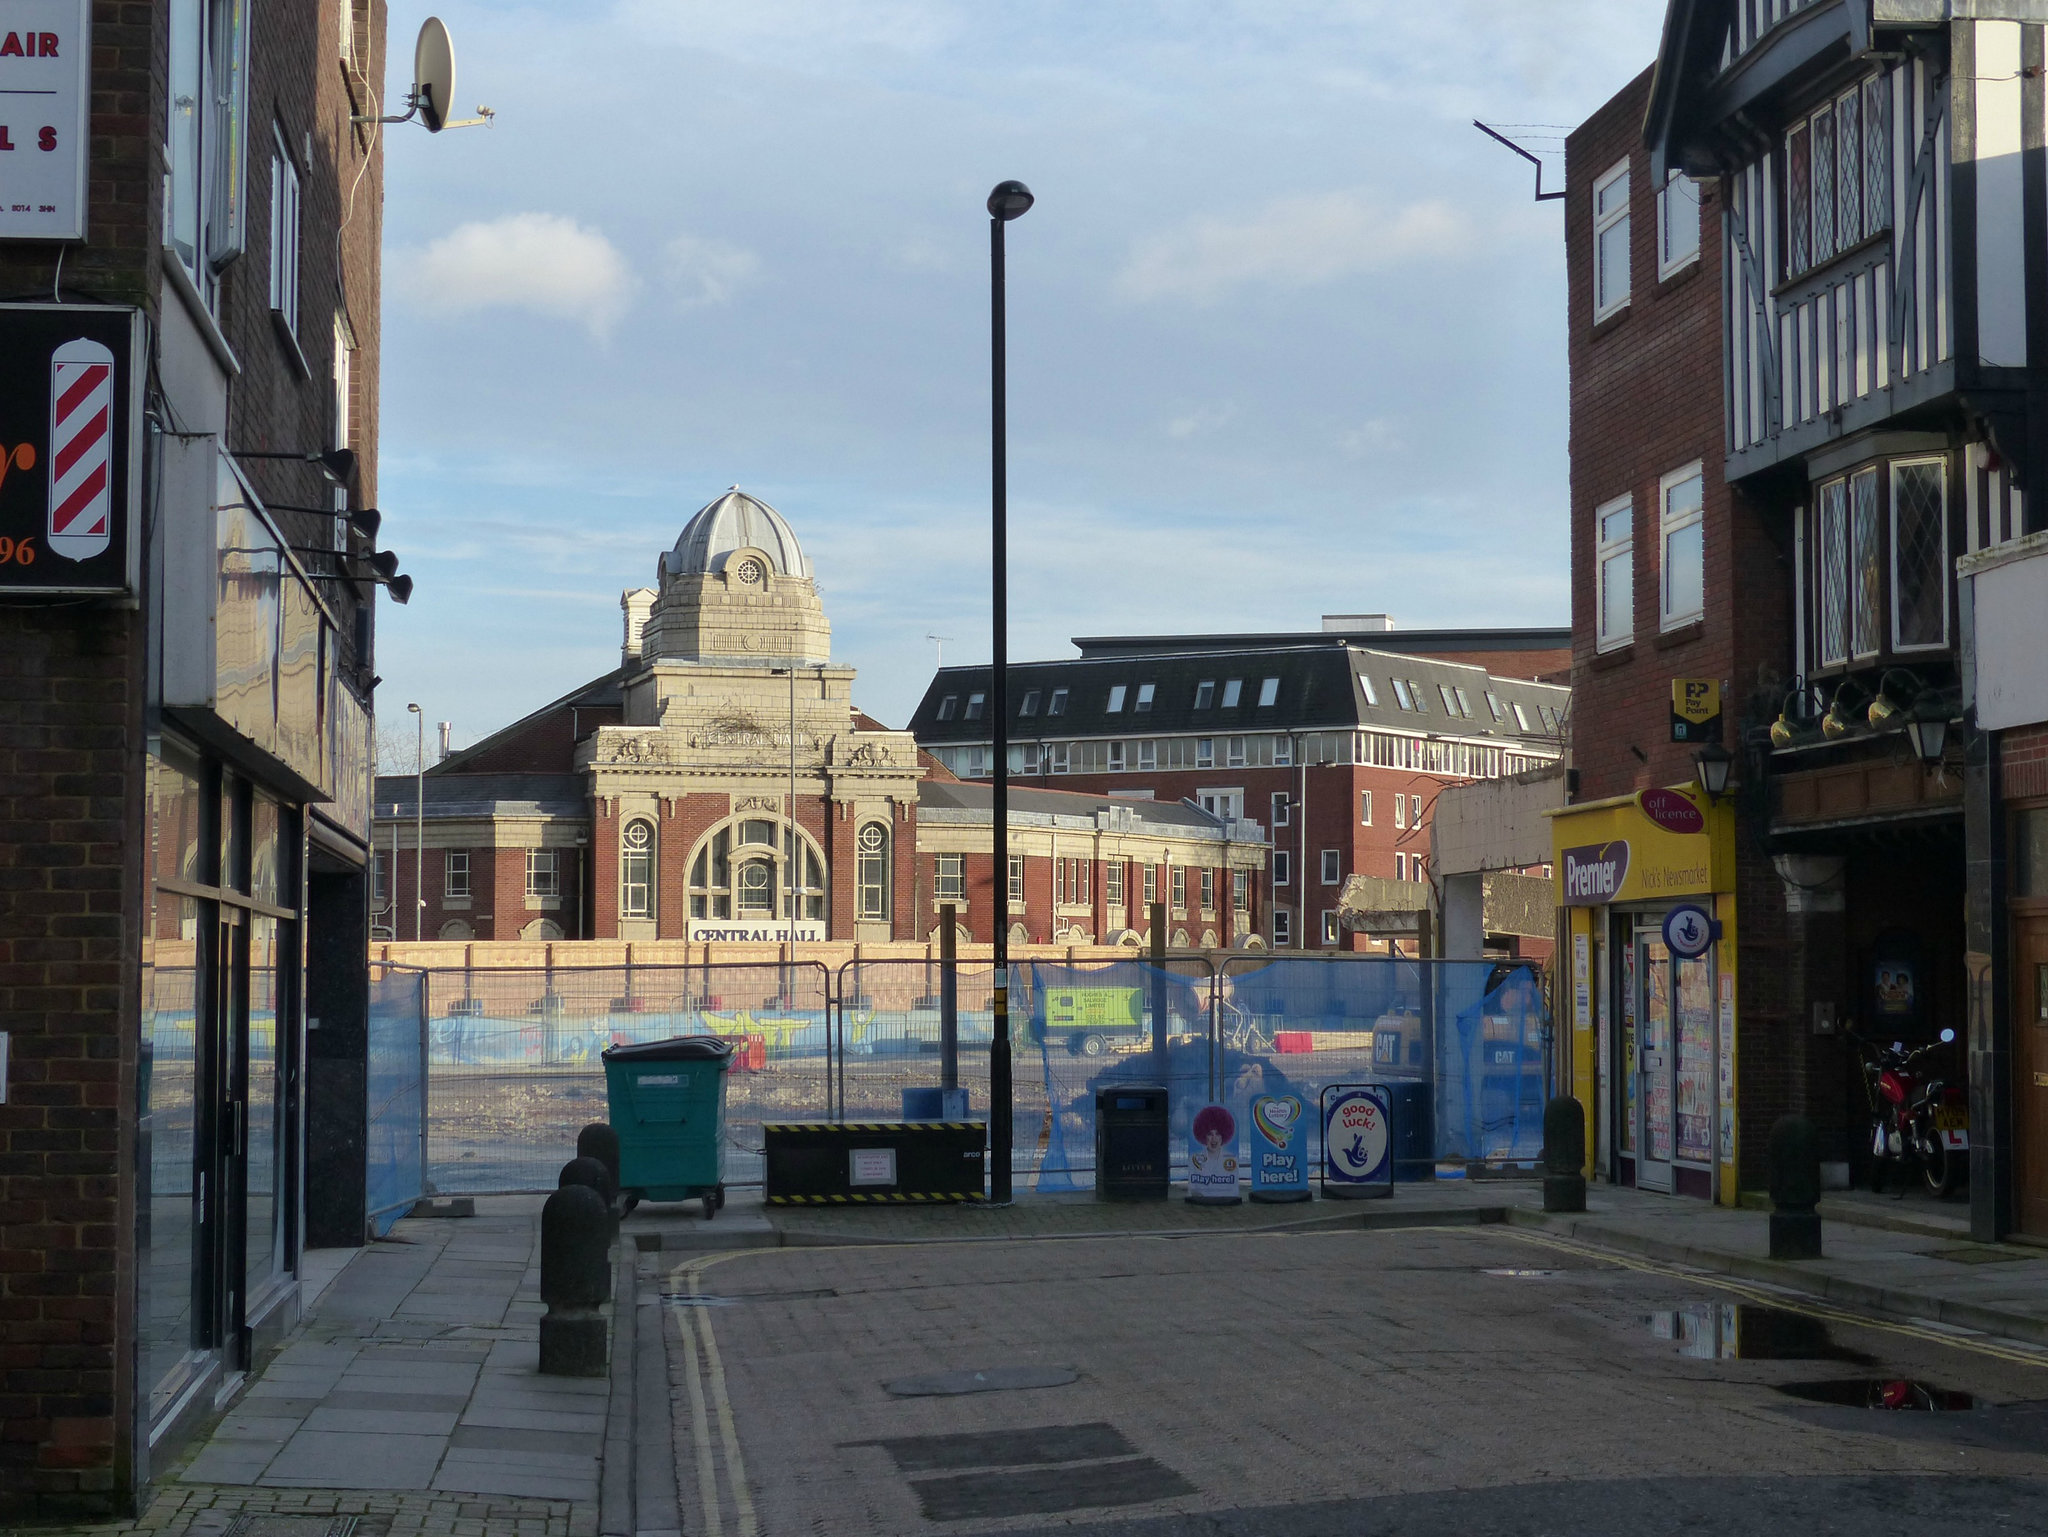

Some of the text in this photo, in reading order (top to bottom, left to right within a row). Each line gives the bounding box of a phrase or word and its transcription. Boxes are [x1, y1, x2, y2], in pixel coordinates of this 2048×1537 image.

[0, 32, 59, 57] AIR
[1686, 699, 1701, 708] Pay
[1649, 797, 1666, 808] off
[1655, 808, 1696, 819] licence
[1567, 855, 1616, 897] Premier
[1642, 861, 1708, 889] Nick's Newsmarket
[693, 929, 773, 941] CENTRAL
[776, 930, 821, 941] HALL
[1376, 1033, 1395, 1063] CAT
[1495, 1050, 1515, 1064] CAT
[1343, 1105, 1376, 1117] good
[1342, 1118, 1376, 1131] luck!
[1263, 1153, 1295, 1168] Play
[1191, 1174, 1234, 1184] Play here!
[1260, 1169, 1298, 1183] here!
